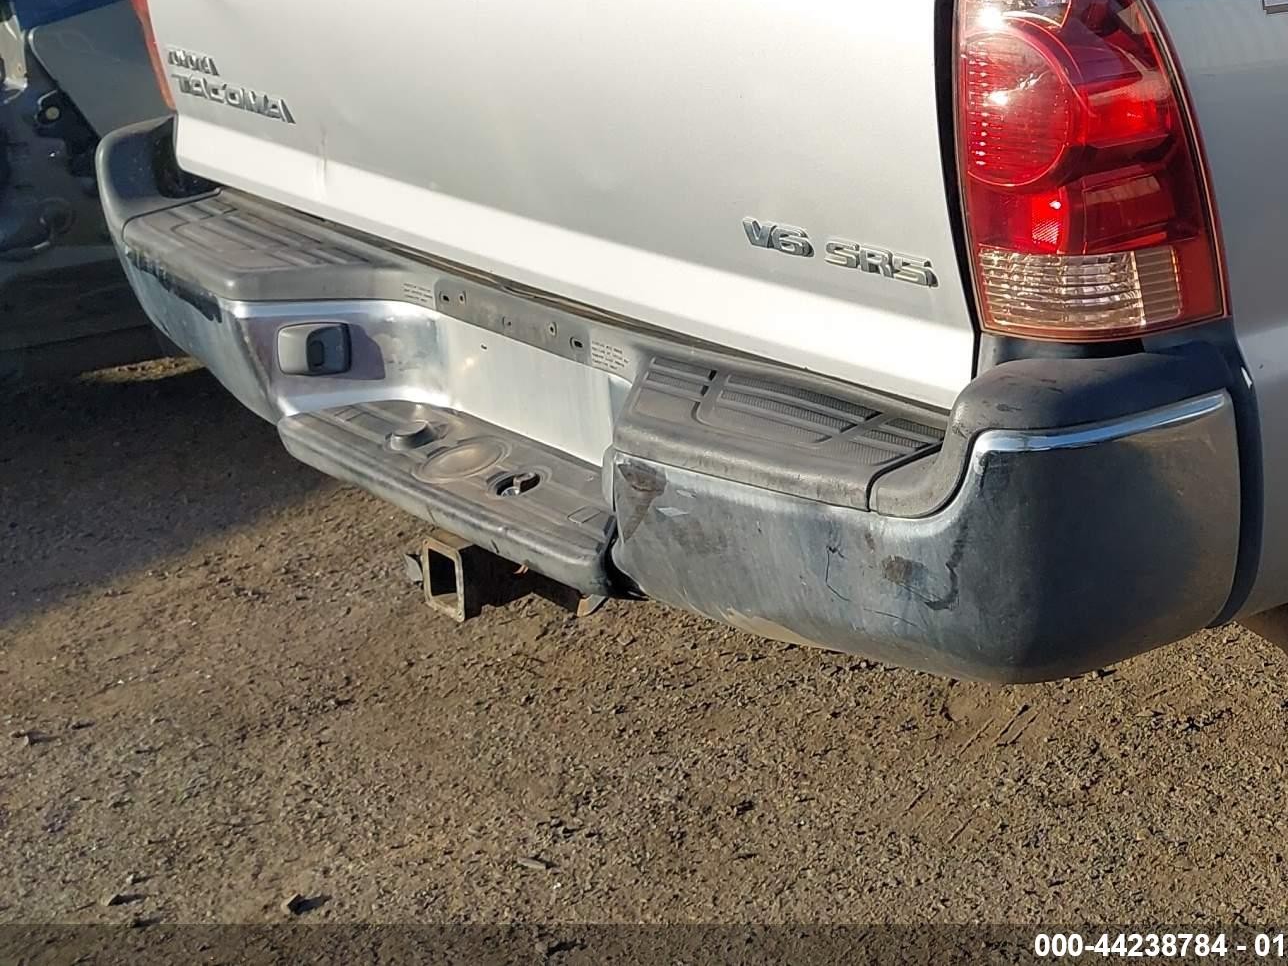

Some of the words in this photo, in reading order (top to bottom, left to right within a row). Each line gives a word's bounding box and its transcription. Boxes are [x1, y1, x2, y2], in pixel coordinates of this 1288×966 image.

[171, 73, 296, 124] TACOMA
[742, 216, 815, 258] V6
[823, 240, 940, 287] SR5
